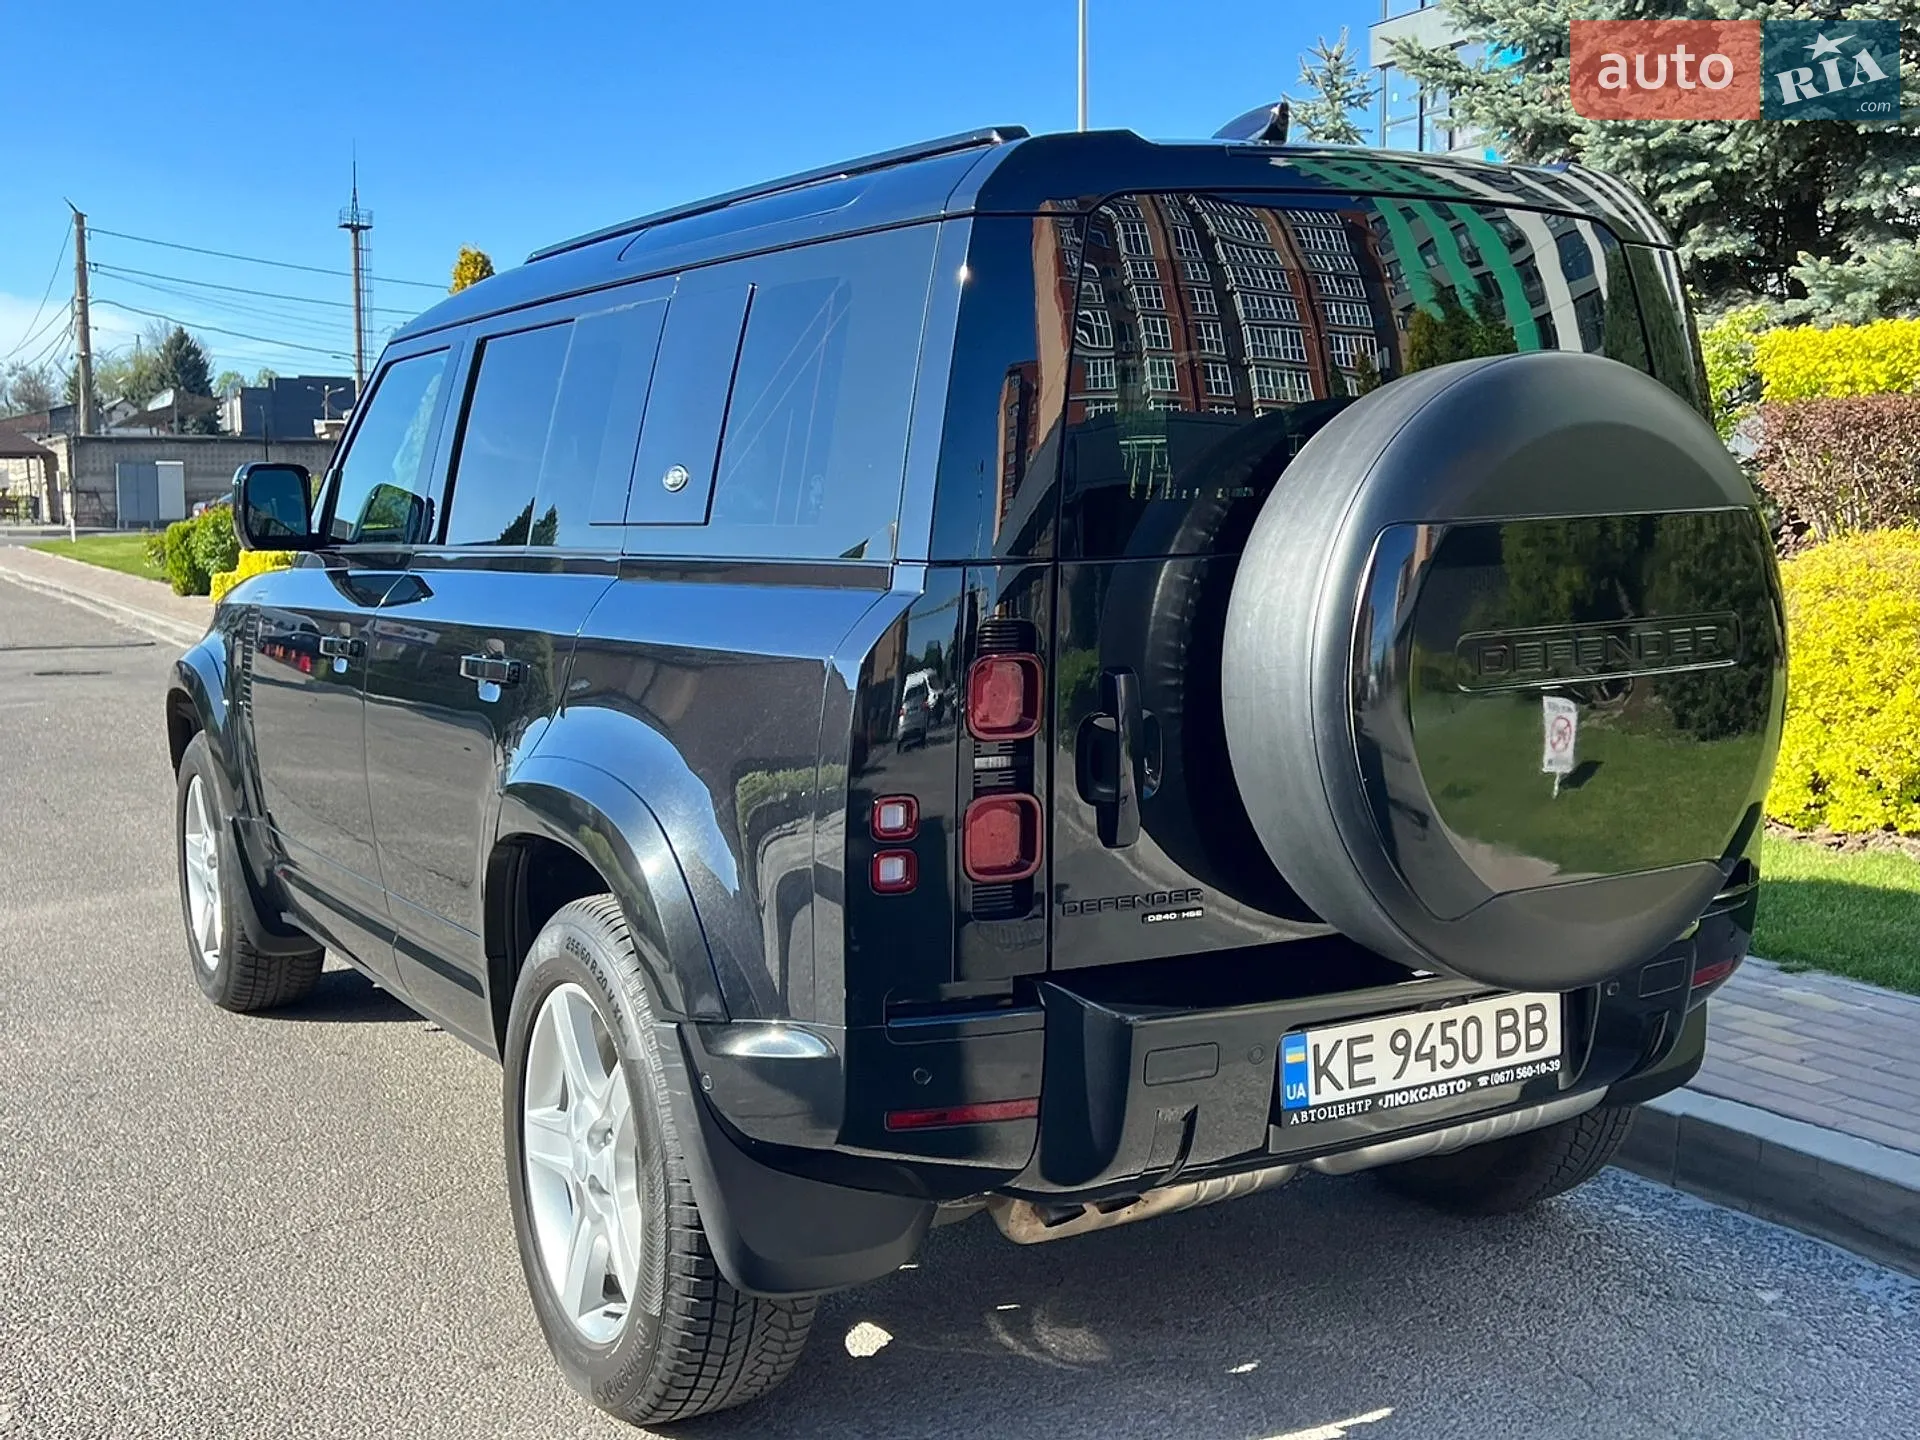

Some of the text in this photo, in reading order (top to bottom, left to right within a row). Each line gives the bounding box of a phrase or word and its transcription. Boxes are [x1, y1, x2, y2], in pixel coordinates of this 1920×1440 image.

[1478, 625, 1724, 676] DEFENDER
[1062, 887, 1204, 917] DEFENDER
[1312, 1002, 1549, 1096] KE 9450 BB
[1286, 1083, 1307, 1101] UA
[1289, 1098, 1373, 1125] АВТОЦЕНТР
